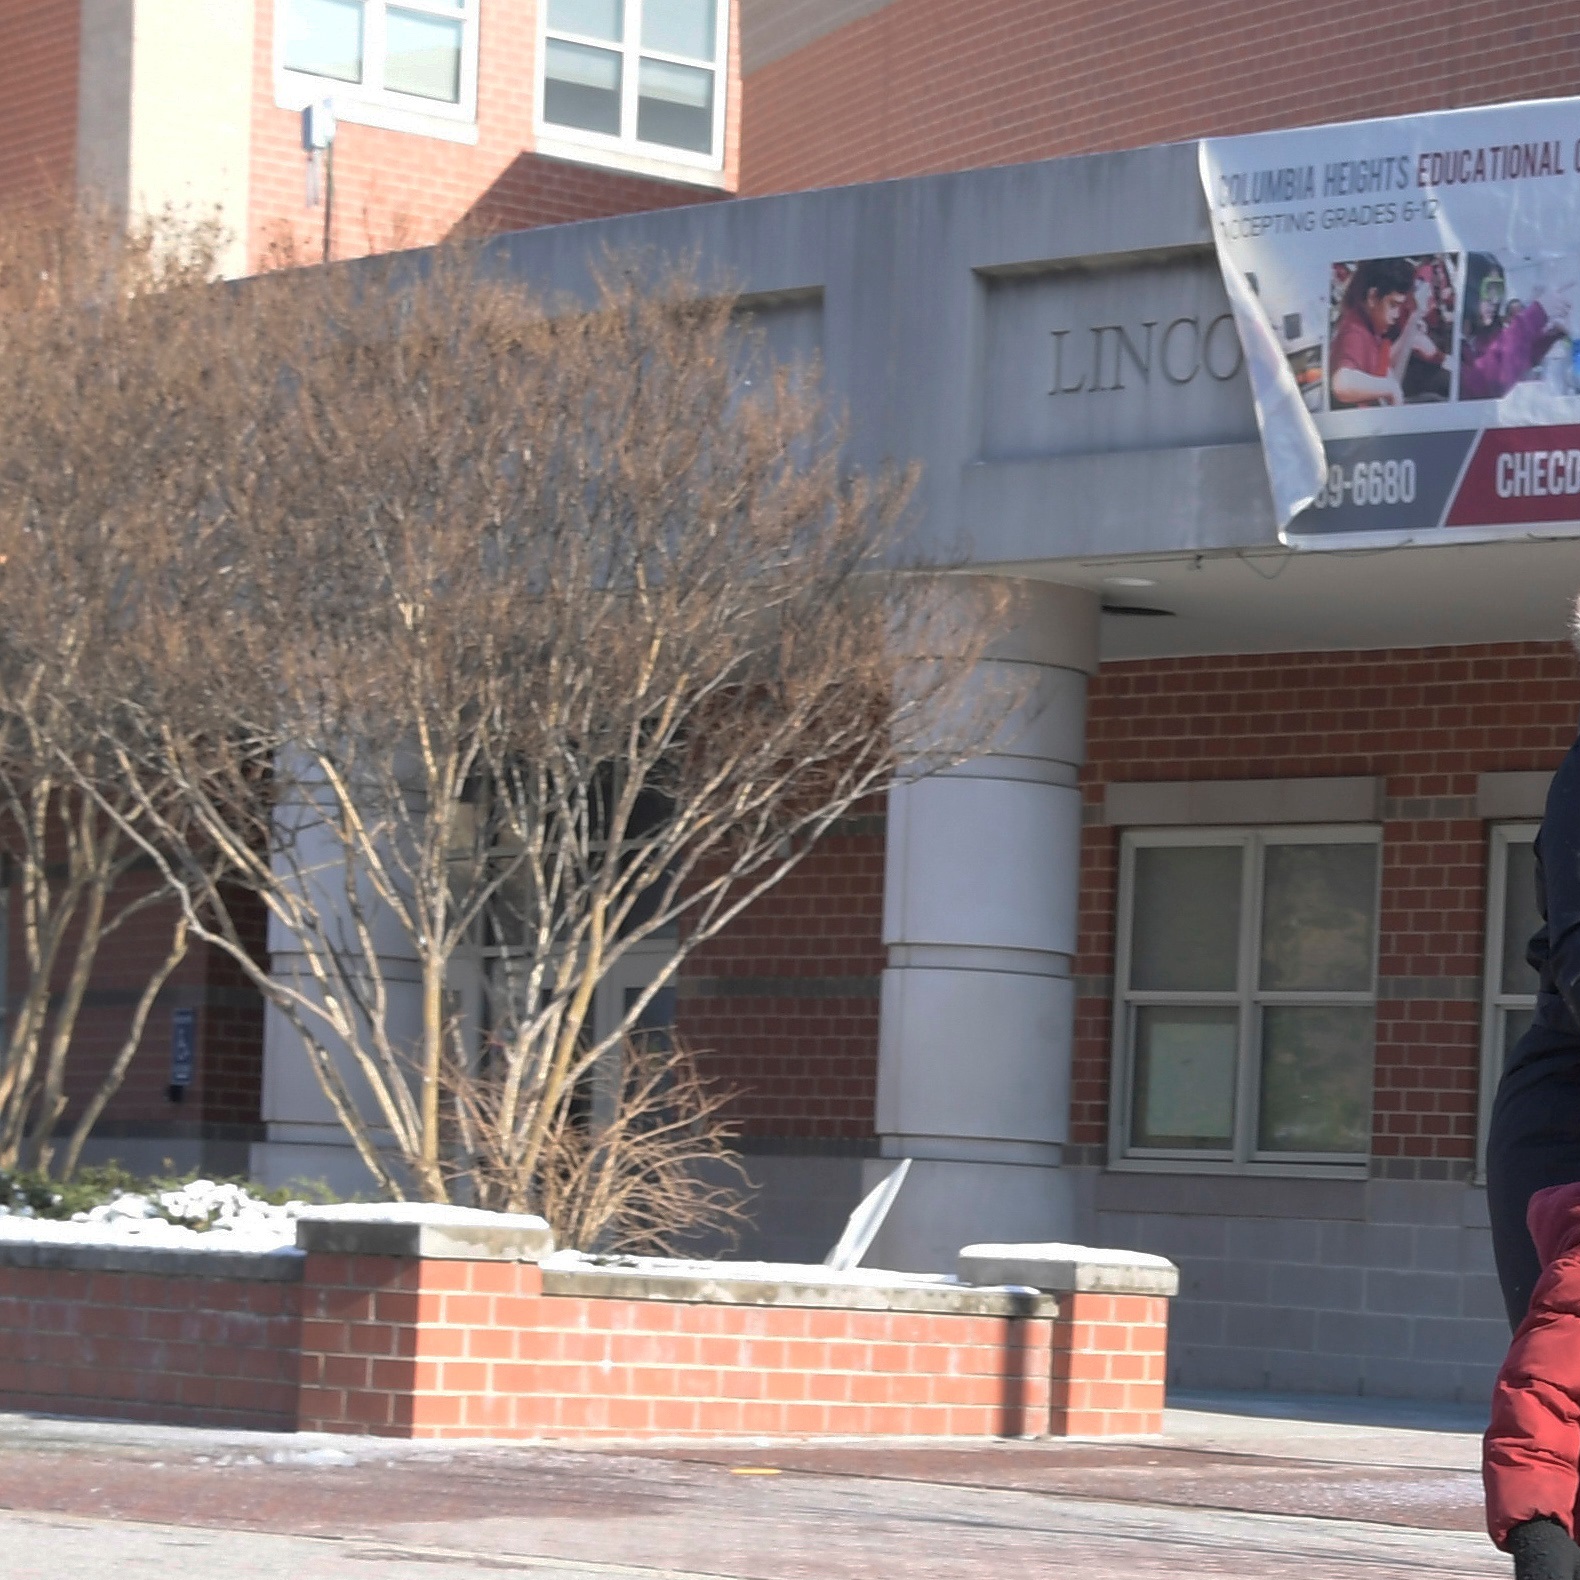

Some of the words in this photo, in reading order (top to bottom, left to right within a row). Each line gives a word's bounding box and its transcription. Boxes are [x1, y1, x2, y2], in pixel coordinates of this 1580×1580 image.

[1323, 154, 1411, 197] HEIGHTS
[1416, 140, 1565, 188] EDUCATIONAL
[1321, 201, 1397, 231] GRADES
[1402, 197, 1439, 222] 6-12
[1048, 313, 1244, 396] LINCO
